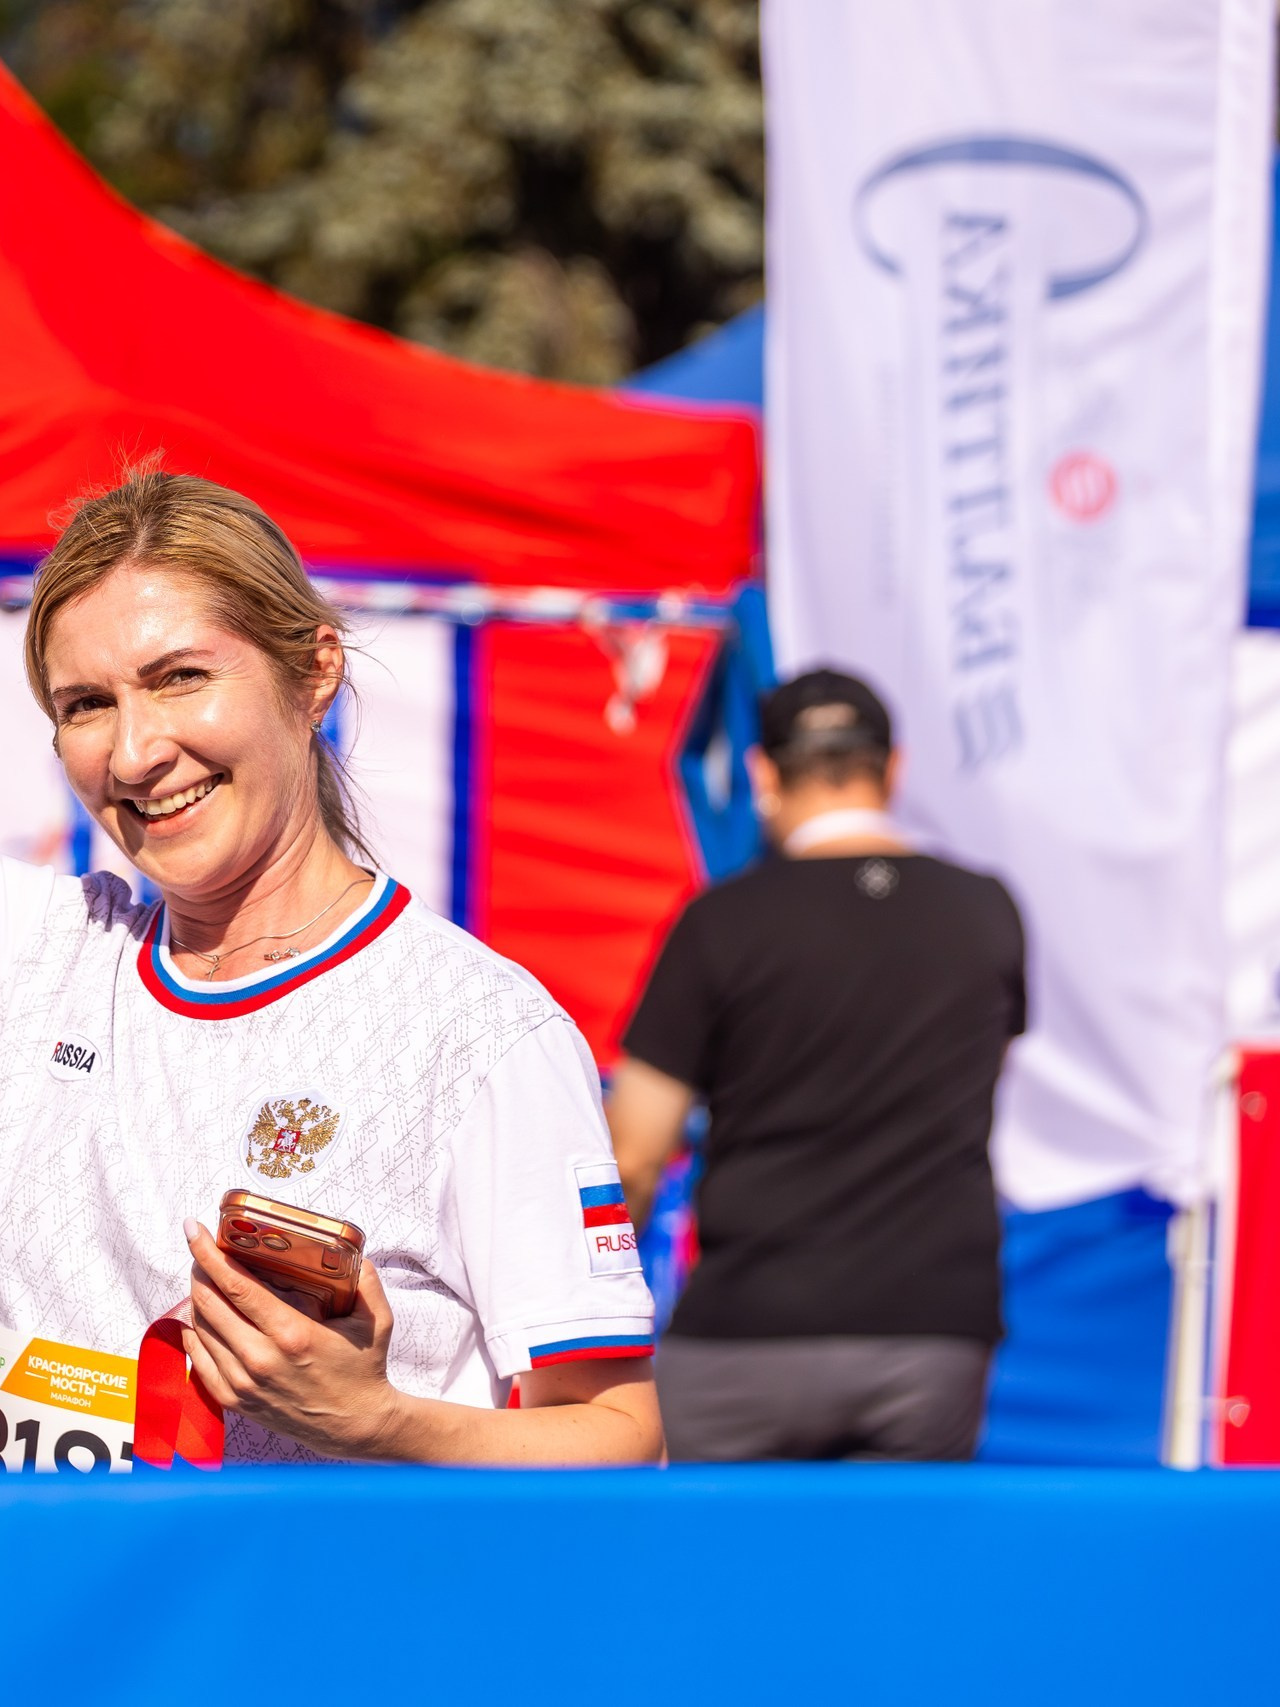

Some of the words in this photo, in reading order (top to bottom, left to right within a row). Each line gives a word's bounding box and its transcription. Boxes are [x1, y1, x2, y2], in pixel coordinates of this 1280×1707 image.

[50, 1041, 96, 1073] RUSSIA
[27, 1355, 128, 1390] КРАСНОЯРСКИЕ
[50, 1375, 96, 1397] МОСТЫ
[50, 1391, 91, 1408] МАРАФОН
